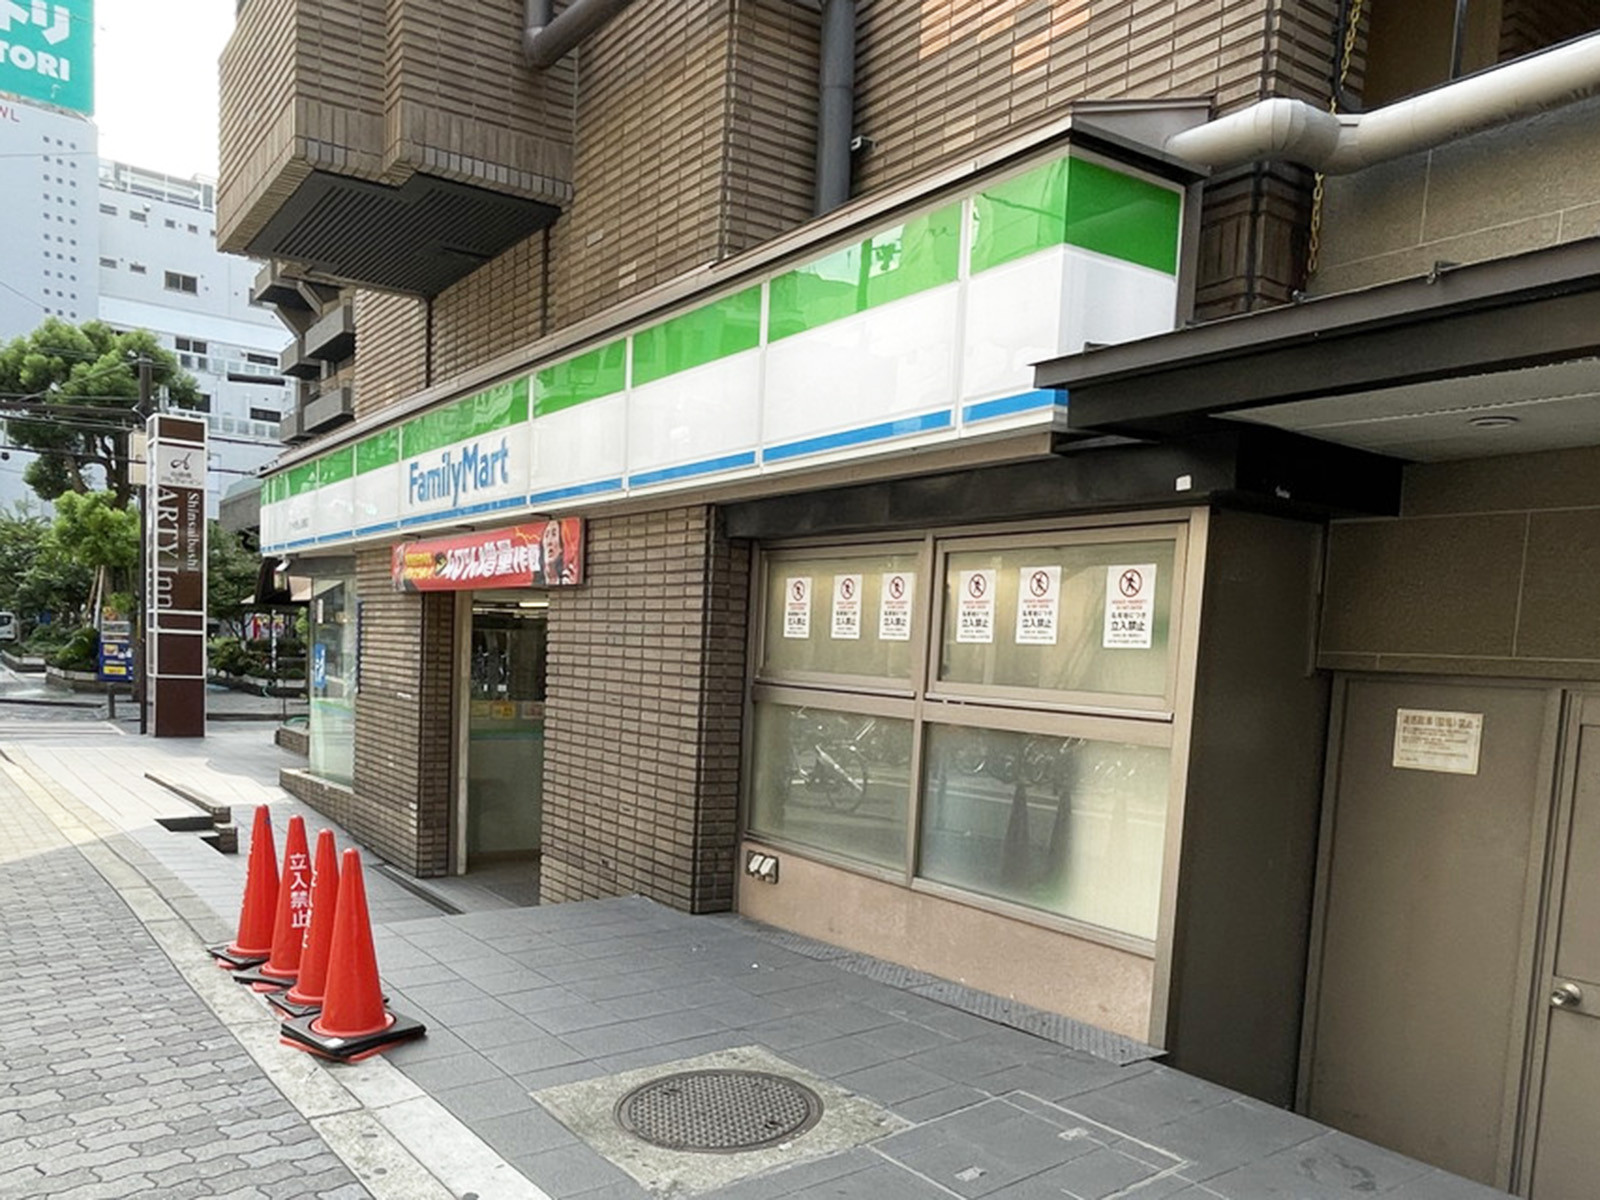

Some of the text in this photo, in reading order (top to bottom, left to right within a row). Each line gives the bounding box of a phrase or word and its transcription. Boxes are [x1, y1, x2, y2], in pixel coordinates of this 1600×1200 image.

[409, 436, 508, 507] FamilyMart
[157, 485, 179, 609] ARTY Inn
[1110, 620, 1146, 632] 立入禁止
[289, 852, 308, 929] 立入禁止
